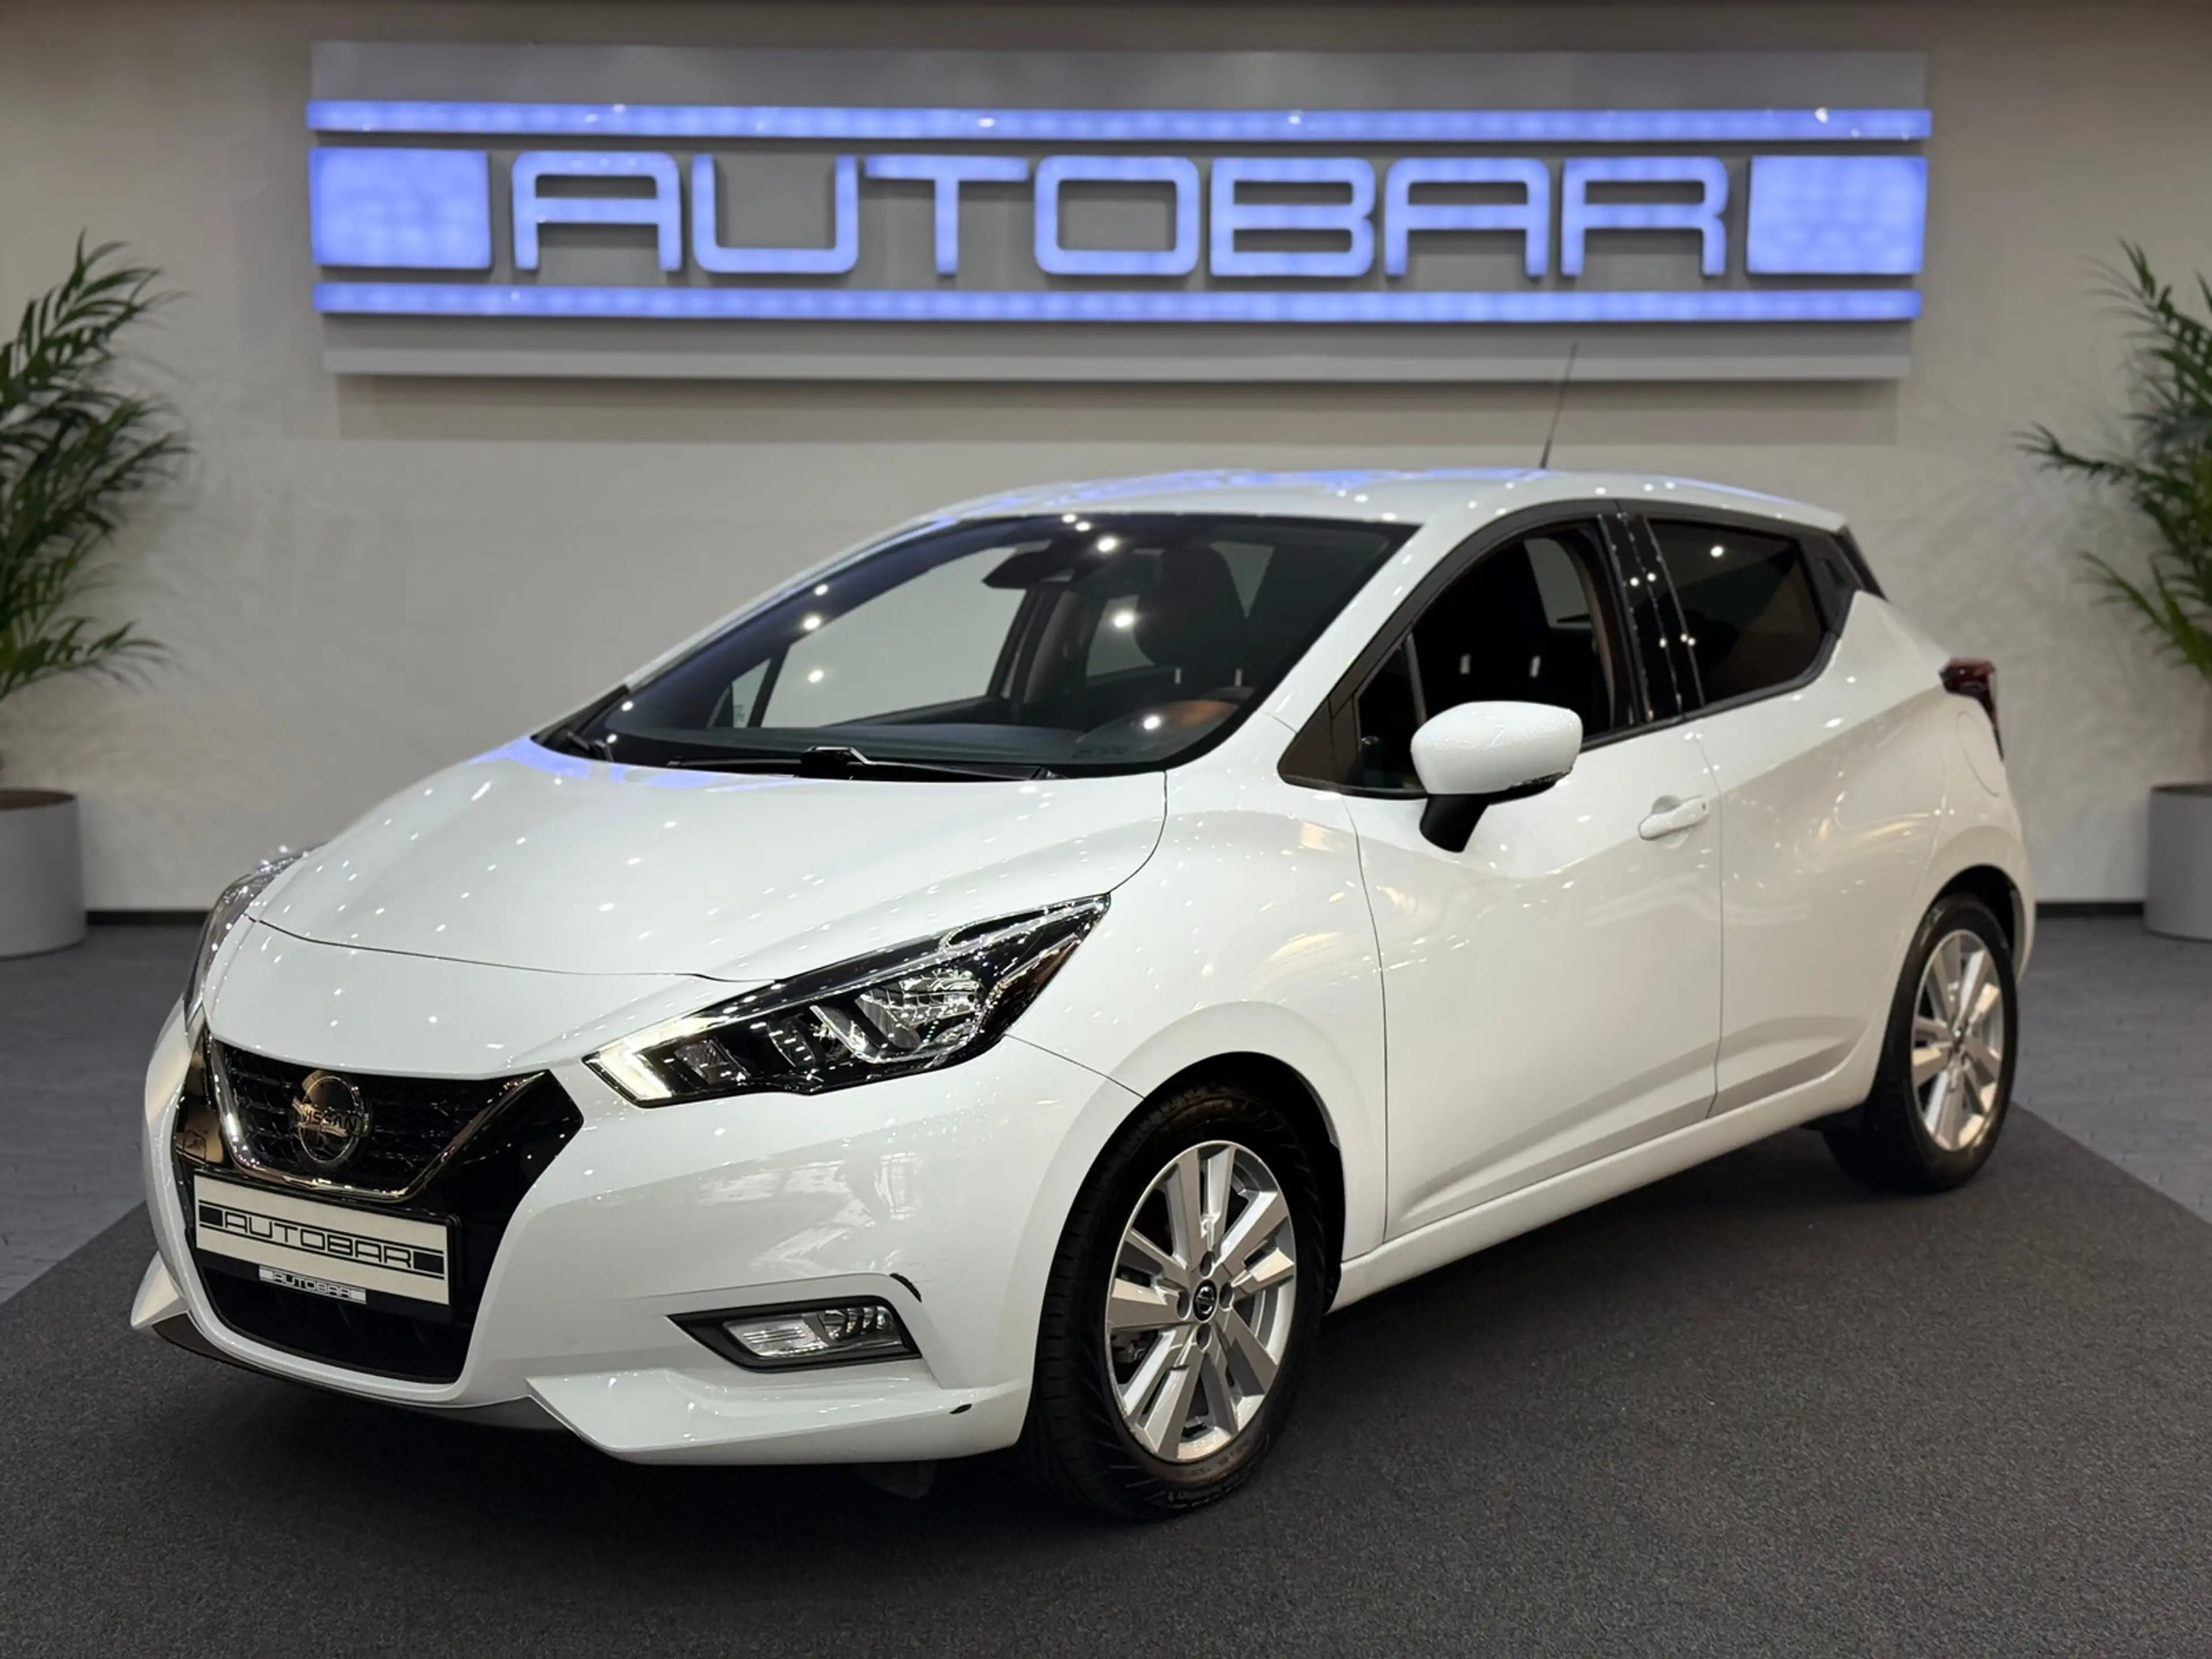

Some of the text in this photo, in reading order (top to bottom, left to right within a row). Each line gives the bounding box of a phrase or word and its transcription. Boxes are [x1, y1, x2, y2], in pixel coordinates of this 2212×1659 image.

[512, 150, 1727, 276] AUTOBAR
[225, 1211, 411, 1268] AUTOBAR
[273, 1271, 352, 1298] AUTOBAR
